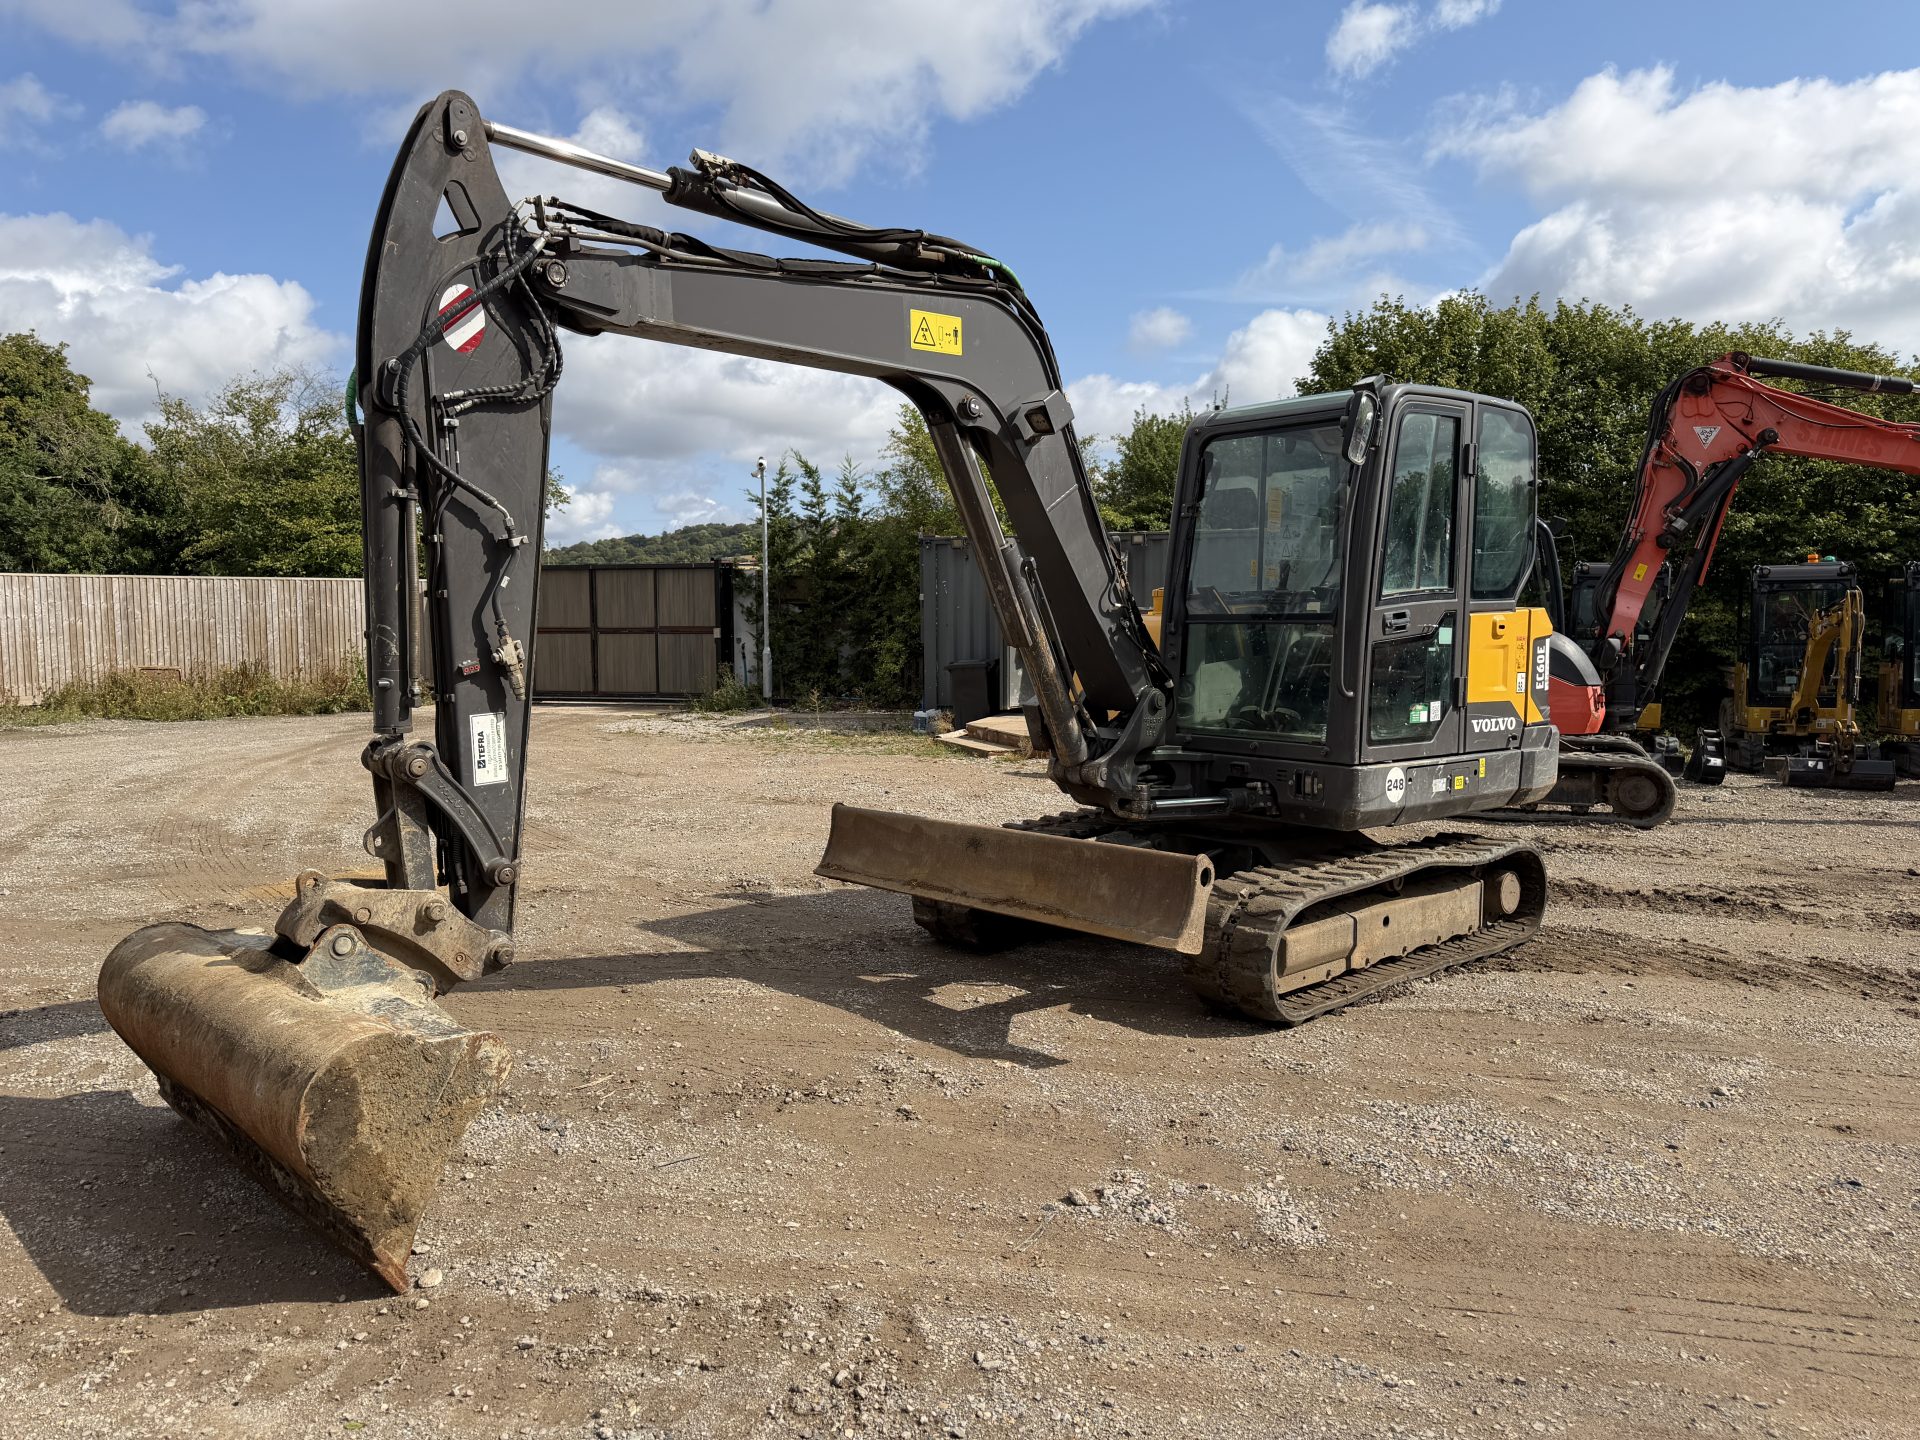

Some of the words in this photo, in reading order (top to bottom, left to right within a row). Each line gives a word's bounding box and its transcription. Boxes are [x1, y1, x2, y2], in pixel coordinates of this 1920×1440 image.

[1535, 645, 1546, 690] EC60E
[1471, 717, 1516, 733] VOLVO
[477, 731, 486, 759] TEFRA
[1386, 778, 1404, 791] 248
